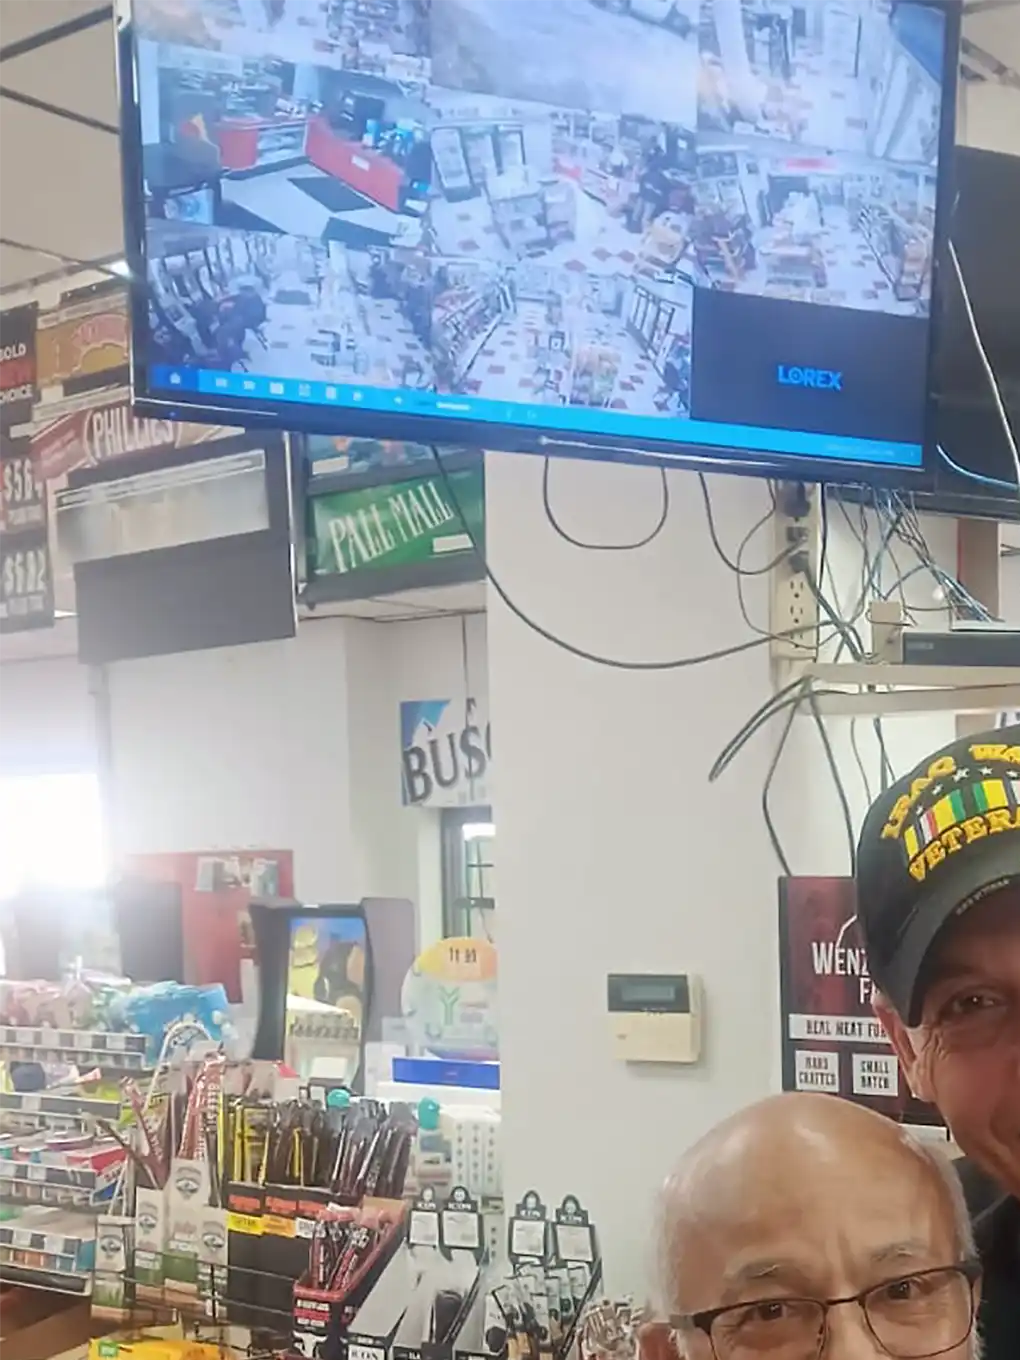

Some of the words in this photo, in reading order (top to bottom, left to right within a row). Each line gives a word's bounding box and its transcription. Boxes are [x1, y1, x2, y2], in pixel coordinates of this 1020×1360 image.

[778, 364, 842, 391] LOREX
[328, 503, 396, 574] PALL
[388, 480, 455, 544] MALL
[403, 722, 491, 804] BUS
